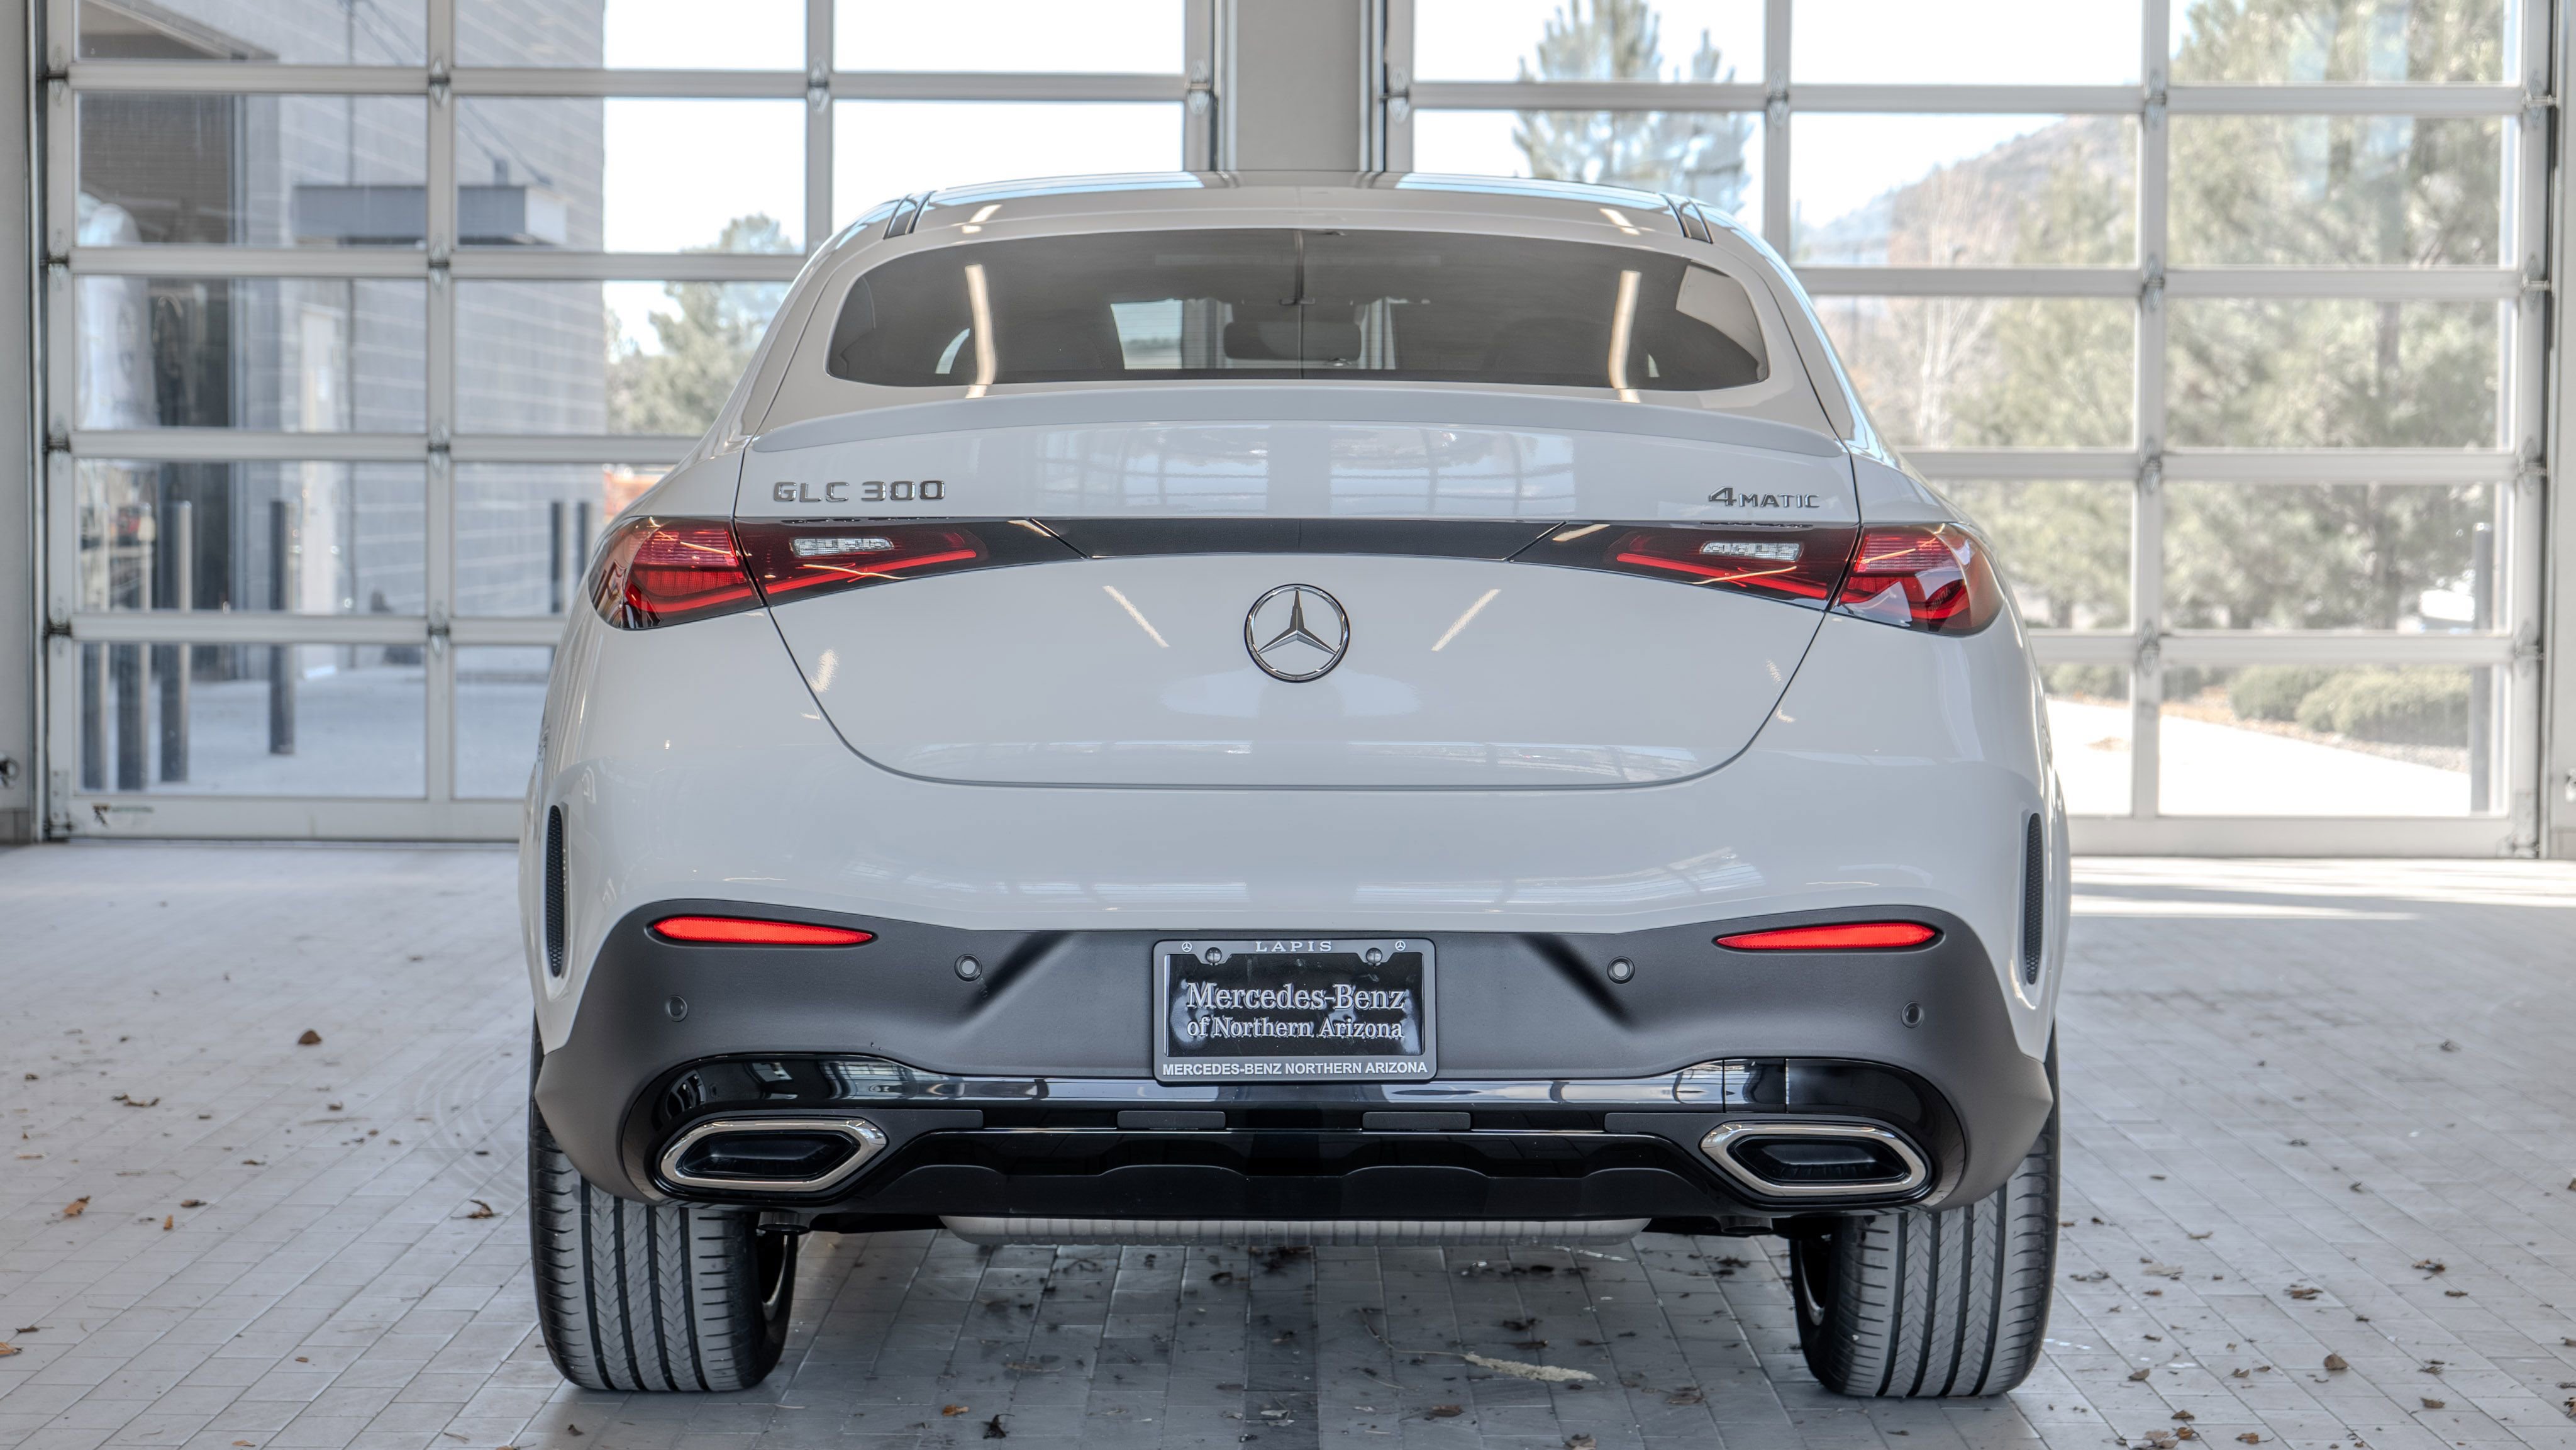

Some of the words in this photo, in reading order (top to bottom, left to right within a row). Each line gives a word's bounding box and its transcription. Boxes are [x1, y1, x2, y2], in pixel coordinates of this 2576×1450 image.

[773, 481, 850, 502] GLC
[861, 481, 946, 501] 300
[1708, 486, 1820, 508] 4MATIC
[1255, 941, 1333, 952] LAPIS
[1186, 982, 1405, 1010] Mercedes-Benz
[1186, 1017, 1211, 1037] of
[1214, 1017, 1313, 1037] Northern
[1319, 1018, 1403, 1037] Arizona
[1162, 1063, 1282, 1075] MERCEDES-BENZ
[1285, 1062, 1362, 1074] NORTHERN
[1365, 1061, 1428, 1074] ARIZONA
